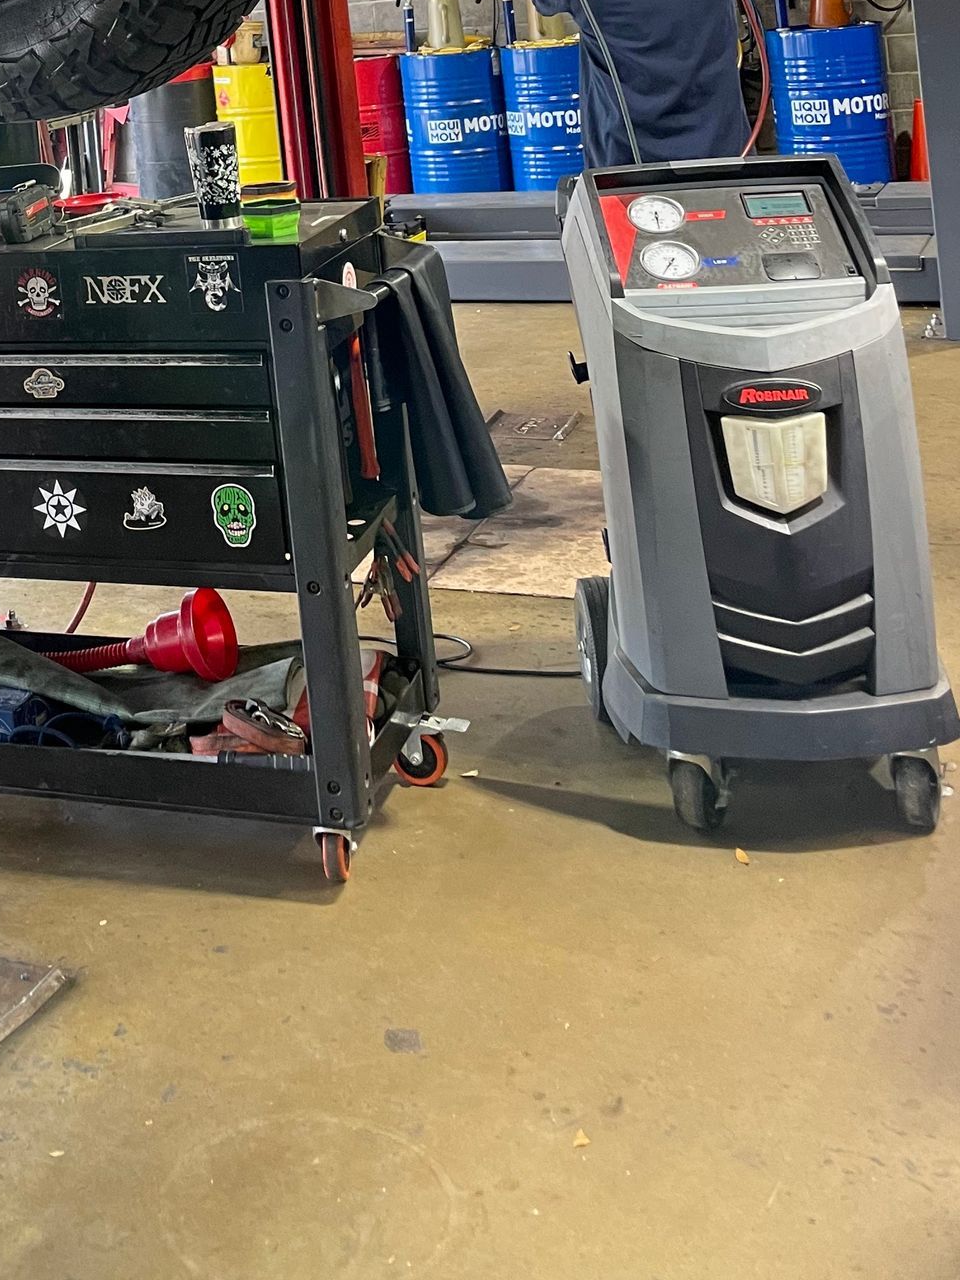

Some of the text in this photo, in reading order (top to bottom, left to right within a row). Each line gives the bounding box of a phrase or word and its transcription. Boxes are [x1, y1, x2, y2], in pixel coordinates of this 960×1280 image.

[793, 93, 890, 116] LIQUI MOTOR
[429, 119, 460, 132] LIQUI
[464, 113, 505, 134] MOTO
[794, 112, 829, 124] MOLY
[430, 130, 462, 142] MOLY
[82, 274, 168, 305] NOFX
